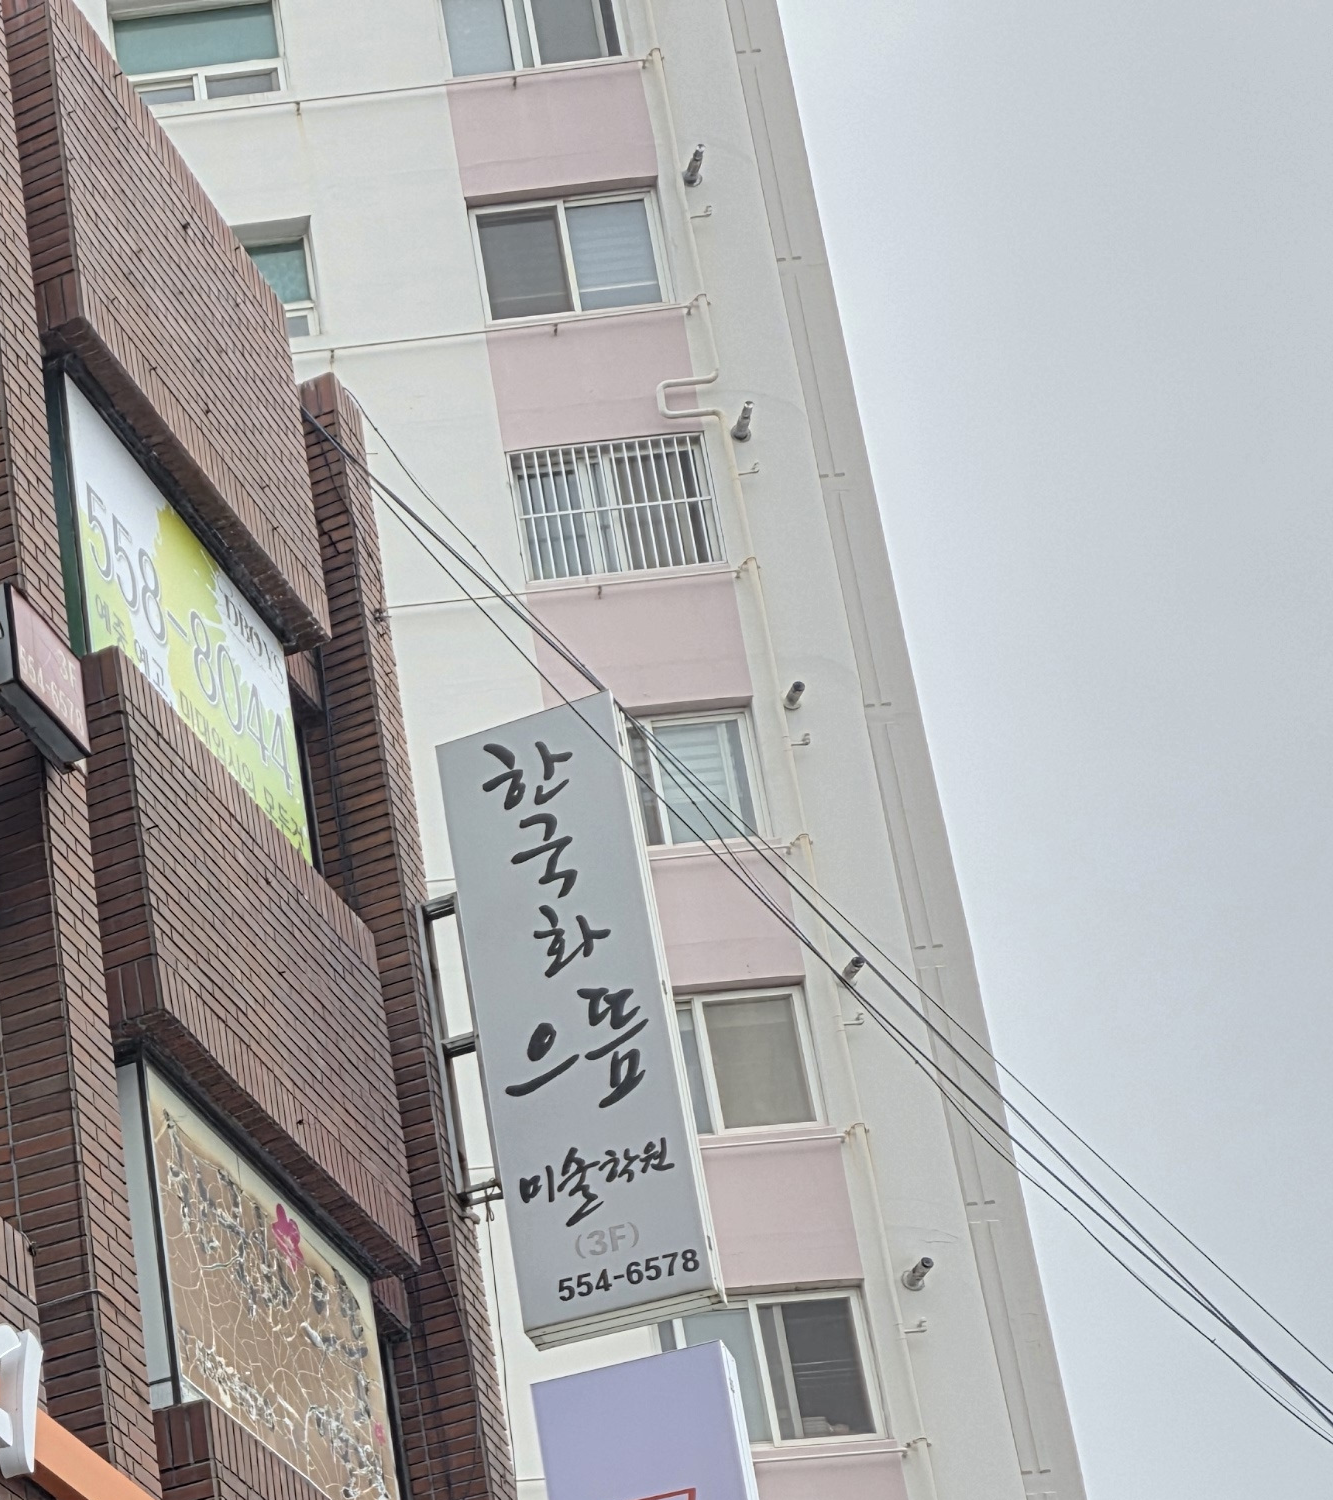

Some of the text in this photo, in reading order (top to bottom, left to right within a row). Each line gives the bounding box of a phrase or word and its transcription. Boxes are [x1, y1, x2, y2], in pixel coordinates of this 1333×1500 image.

[56, 650, 77, 691] 3F
[85, 481, 295, 798] 558-8044
[19, 645, 85, 738] 554-6578
[482, 741, 611, 978] 한국화
[505, 987, 649, 1109] 으뜸
[518, 1136, 675, 1227] 미술학원
[557, 1248, 701, 1302] 554-6578
[574, 1220, 641, 1259] (3F)
